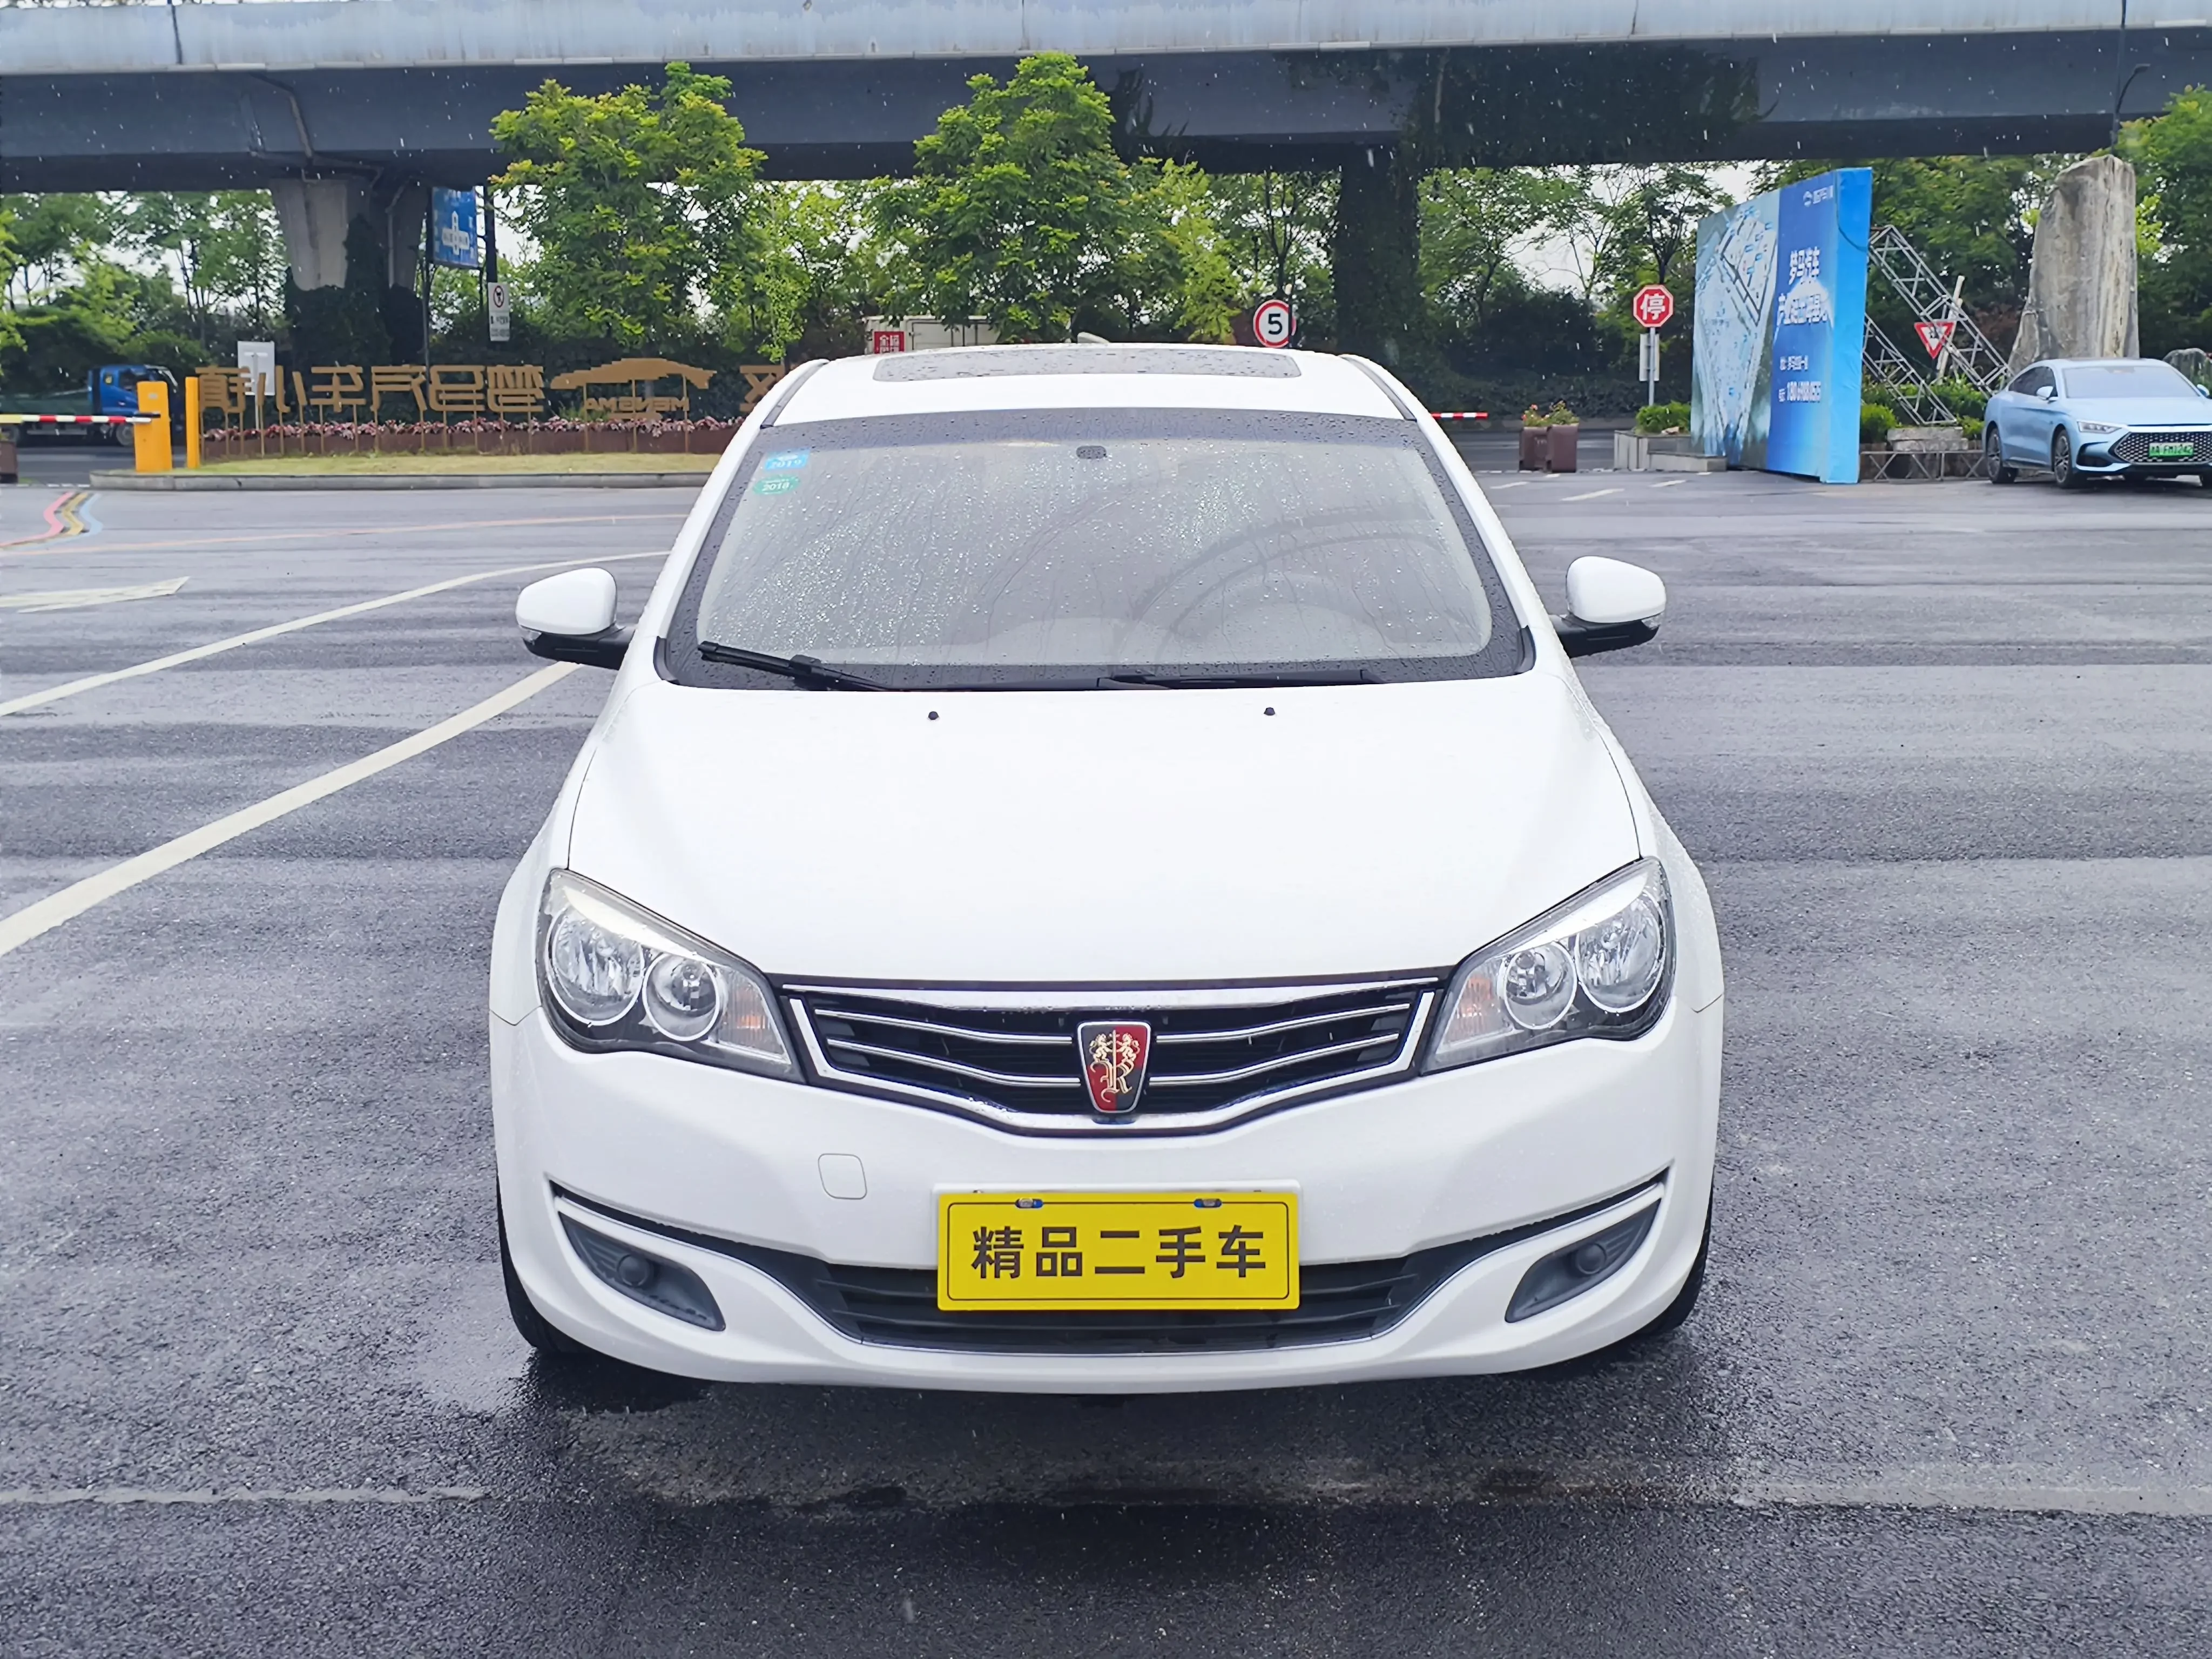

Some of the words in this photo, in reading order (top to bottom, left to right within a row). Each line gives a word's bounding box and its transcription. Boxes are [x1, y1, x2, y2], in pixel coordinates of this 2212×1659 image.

[1640, 293, 1665, 320] 停
[1268, 313, 1283, 335] 5
[972, 1225, 1266, 1279] 精品二手车
